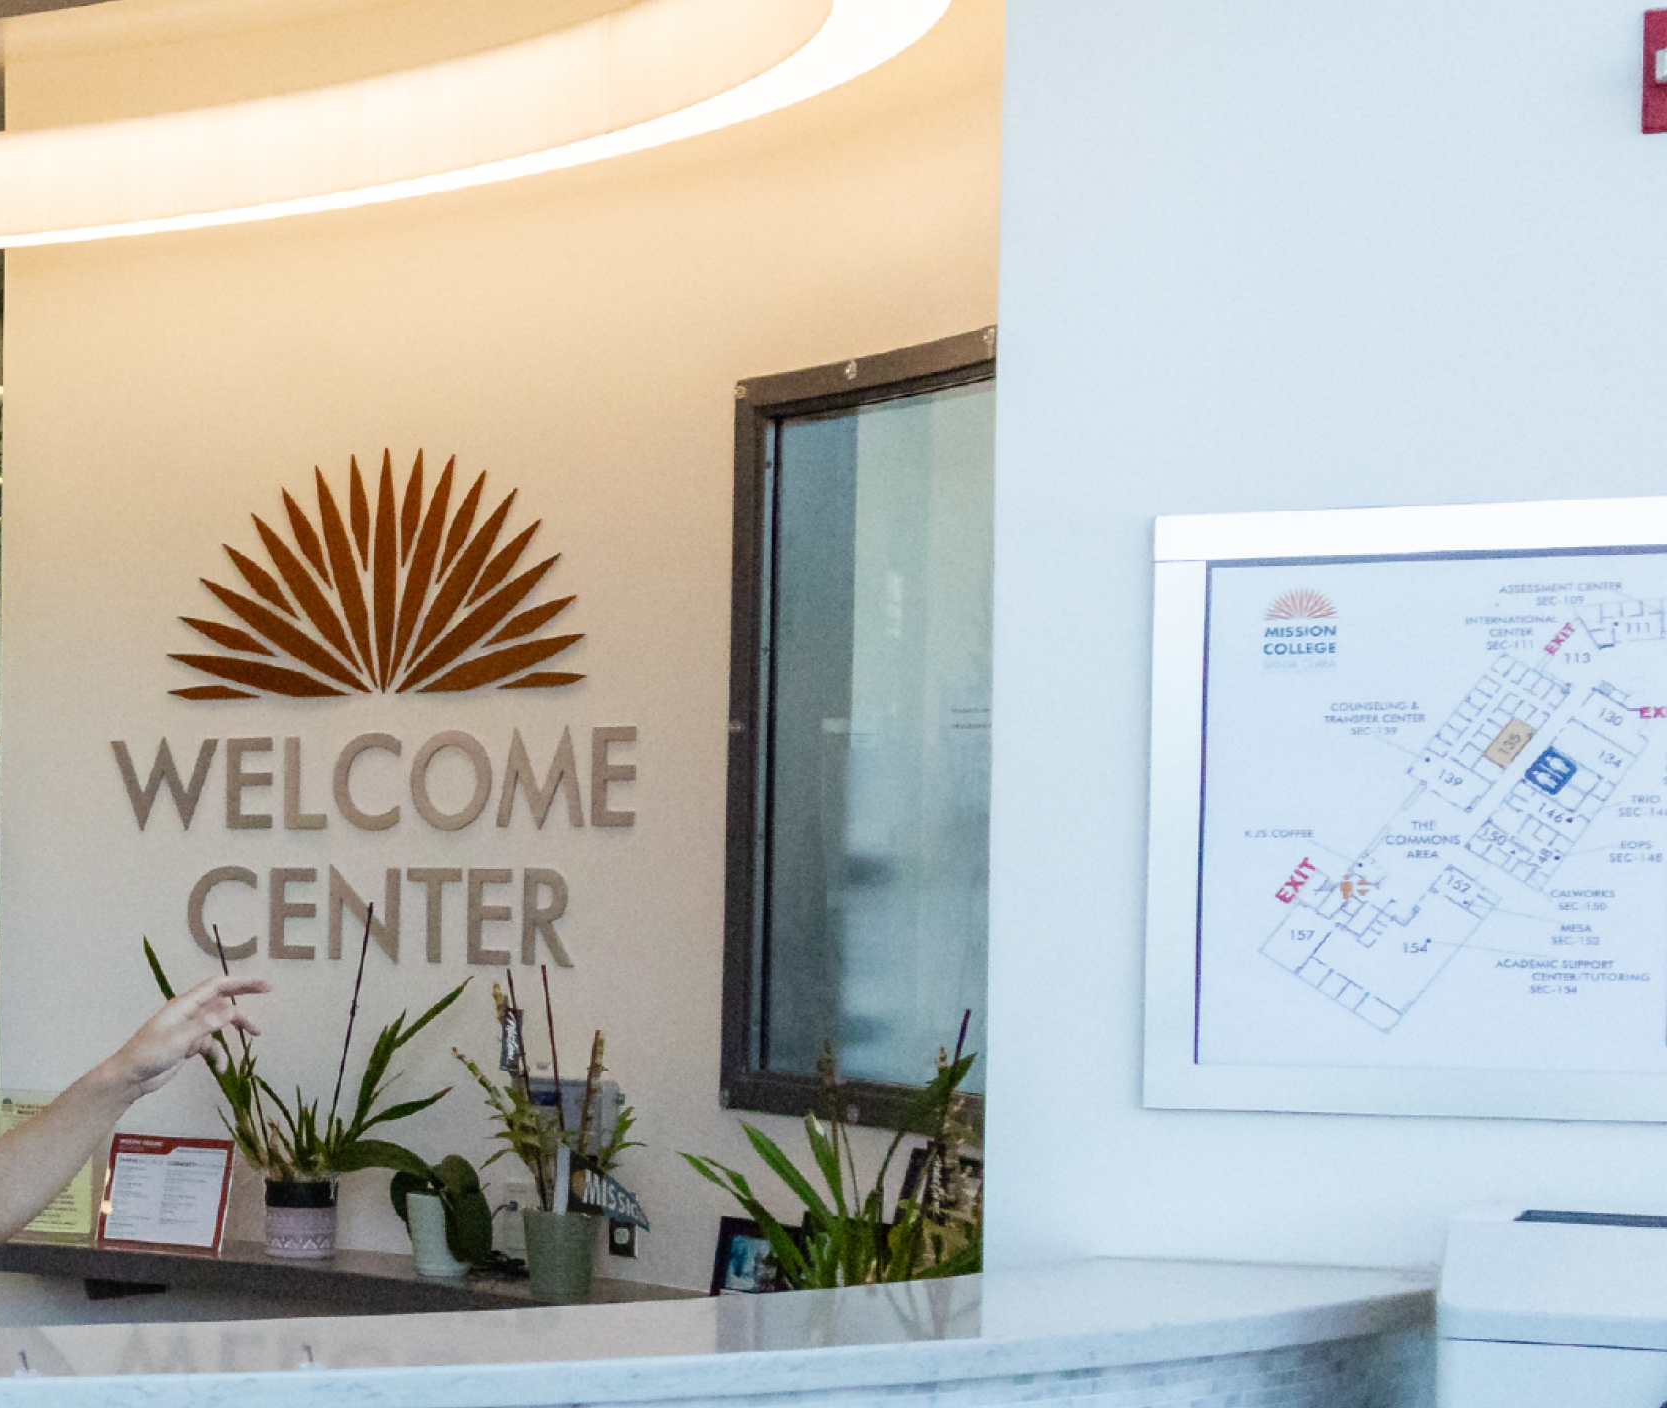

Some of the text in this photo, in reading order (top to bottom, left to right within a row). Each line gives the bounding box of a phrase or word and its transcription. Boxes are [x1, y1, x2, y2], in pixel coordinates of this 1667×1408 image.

[1498, 581, 1623, 594] ASSESSMENT CENTER
[1465, 615, 1559, 626] INTERNATIONAL
[1263, 625, 1337, 638] MISSION
[1488, 627, 1534, 638] CENTER
[1625, 622, 1652, 634] 111
[1543, 621, 1576, 656] EXIT
[1263, 641, 1337, 656] COLLEGE
[1563, 652, 1592, 664] 113
[1330, 701, 1420, 712] COUNSELING &
[1323, 713, 1427, 723] TRANSFER CENTER
[1597, 706, 1625, 727] 130
[1497, 732, 1522, 756] 135
[109, 725, 637, 832] WELCOME
[1437, 768, 1464, 786] 139
[1631, 794, 1661, 804] TRIO
[1538, 801, 1563, 824] 146
[1410, 819, 1437, 831] THE
[1271, 829, 1314, 838] COFFEE
[1480, 827, 1508, 846] 150
[1385, 834, 1462, 846] COMMONS
[1619, 840, 1653, 850] EOPS
[1406, 850, 1440, 859] AREA
[1274, 856, 1317, 904] EXIT
[1445, 875, 1472, 894] 152
[185, 863, 574, 969] CENTER
[1560, 924, 1593, 934] MESA
[1289, 930, 1315, 941] 157
[1402, 941, 1429, 954] 154
[1495, 959, 1615, 969] ACADEMIC SUPPORT
[1531, 972, 1651, 982] CENTER/TUTORING
